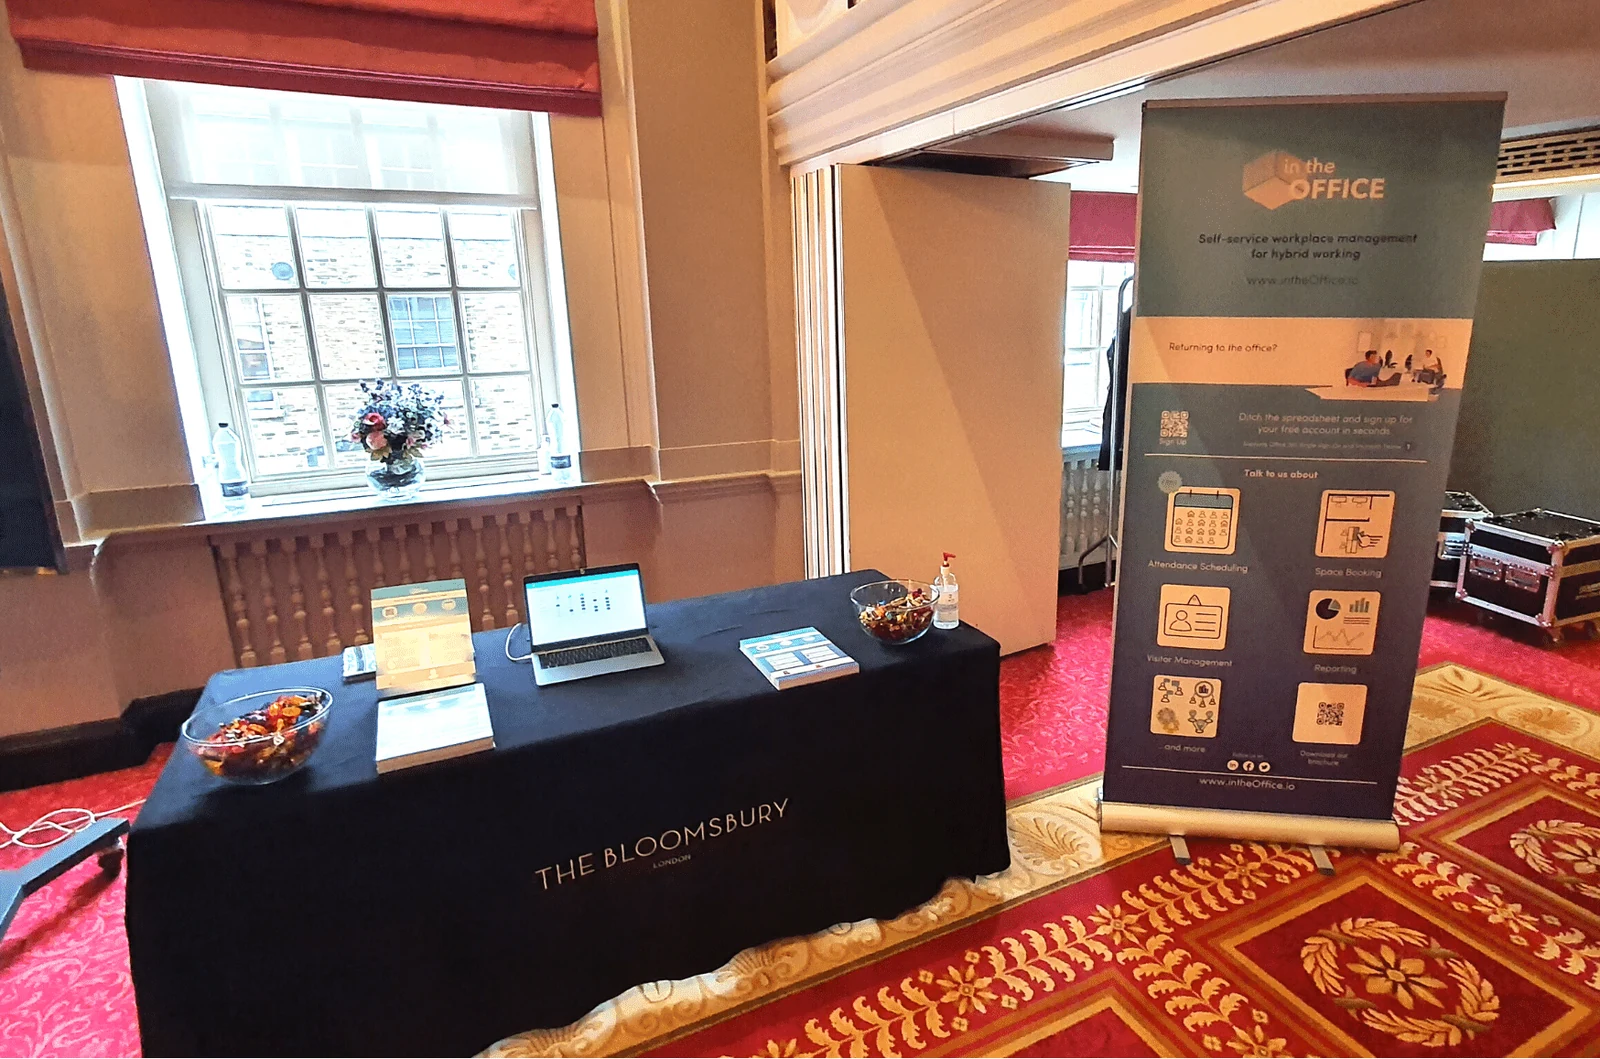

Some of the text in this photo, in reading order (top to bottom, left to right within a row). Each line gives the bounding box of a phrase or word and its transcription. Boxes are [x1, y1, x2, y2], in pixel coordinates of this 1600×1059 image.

[1283, 157, 1336, 174] in the
[1289, 177, 1386, 200] OFFICE
[1198, 233, 1418, 245] Self-service workplace management
[1250, 248, 1361, 261] for hybrid working
[1169, 342, 1278, 354] Returning to the office?
[1238, 412, 1413, 426] Ditch the spreadsheet and sign up for
[1257, 426, 1278, 435] your
[1281, 425, 1299, 434] free
[1302, 426, 1340, 435] account
[1342, 426, 1351, 435] in
[1244, 468, 1319, 479] Talk to us about
[1147, 559, 1249, 574] Attendance Scheduling
[1315, 567, 1382, 578] Space Booking
[1147, 654, 1233, 668] Visitor Management
[1314, 664, 1357, 675] Reporting
[1183, 745, 1206, 753] more
[1199, 777, 1296, 791] www.intheOffice.io
[535, 798, 789, 890] THE BLOOMSBURY
[652, 853, 692, 869] LONDON
